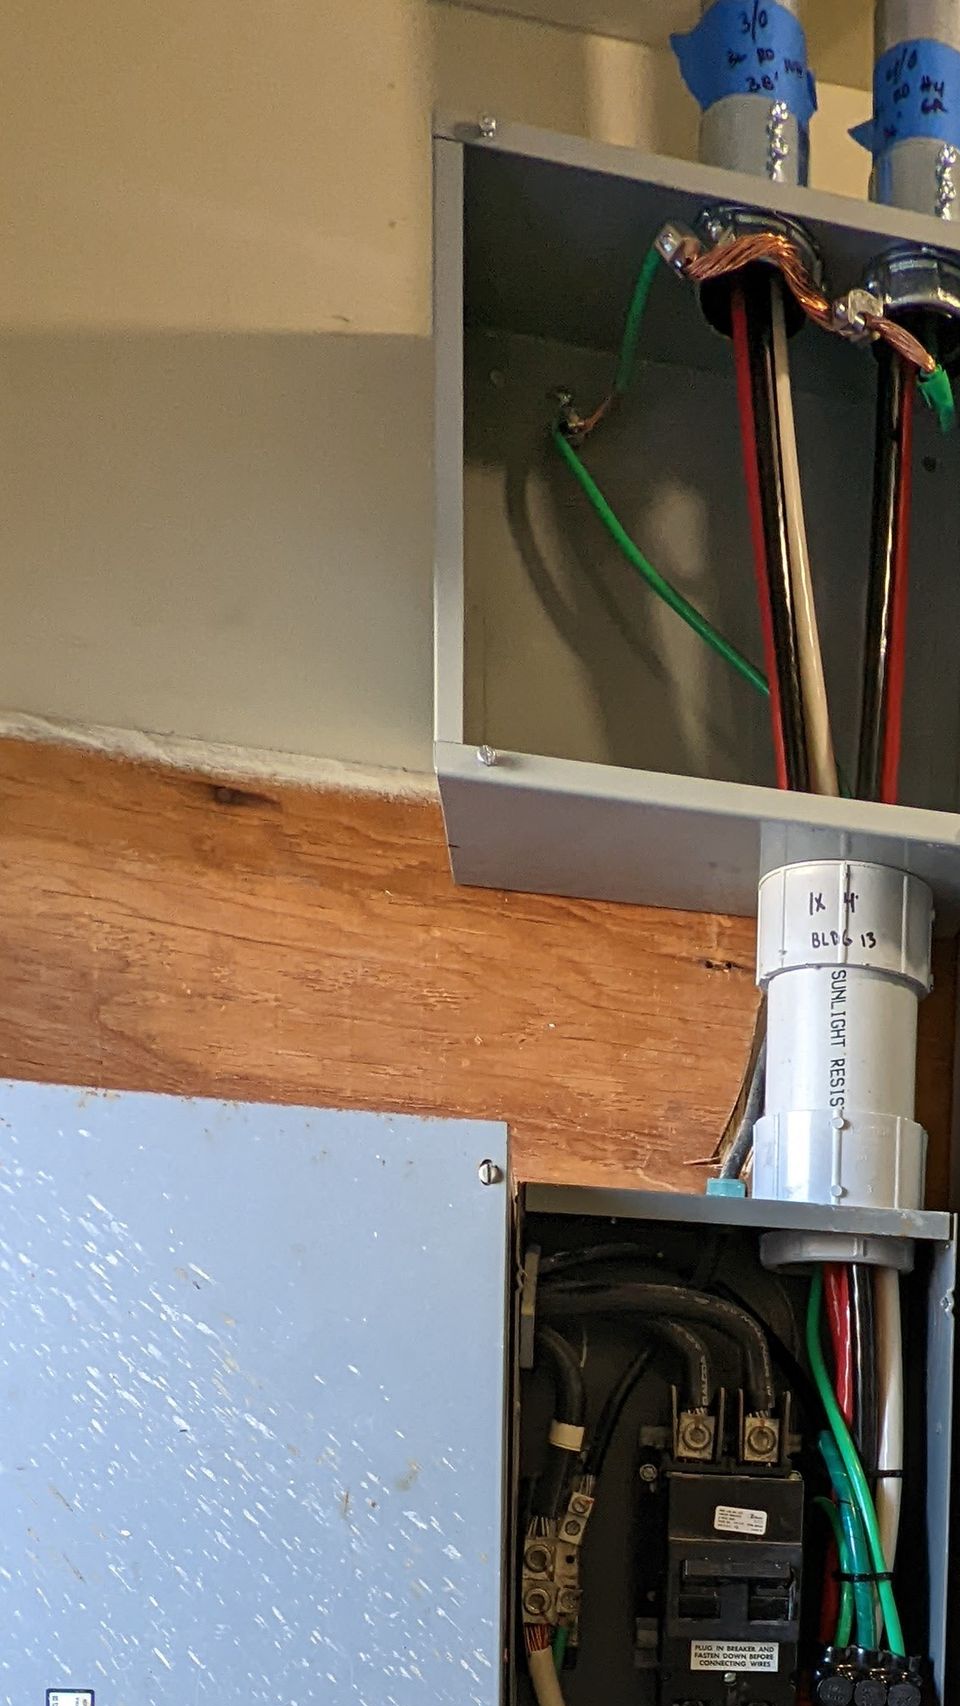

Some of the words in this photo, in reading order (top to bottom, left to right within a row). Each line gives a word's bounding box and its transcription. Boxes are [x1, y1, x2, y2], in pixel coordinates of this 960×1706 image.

[811, 929, 853, 948] BLDG
[861, 931, 876, 948] 13
[830, 969, 846, 1047] SUNLIGHT
[829, 1058, 845, 1108] RESIS
